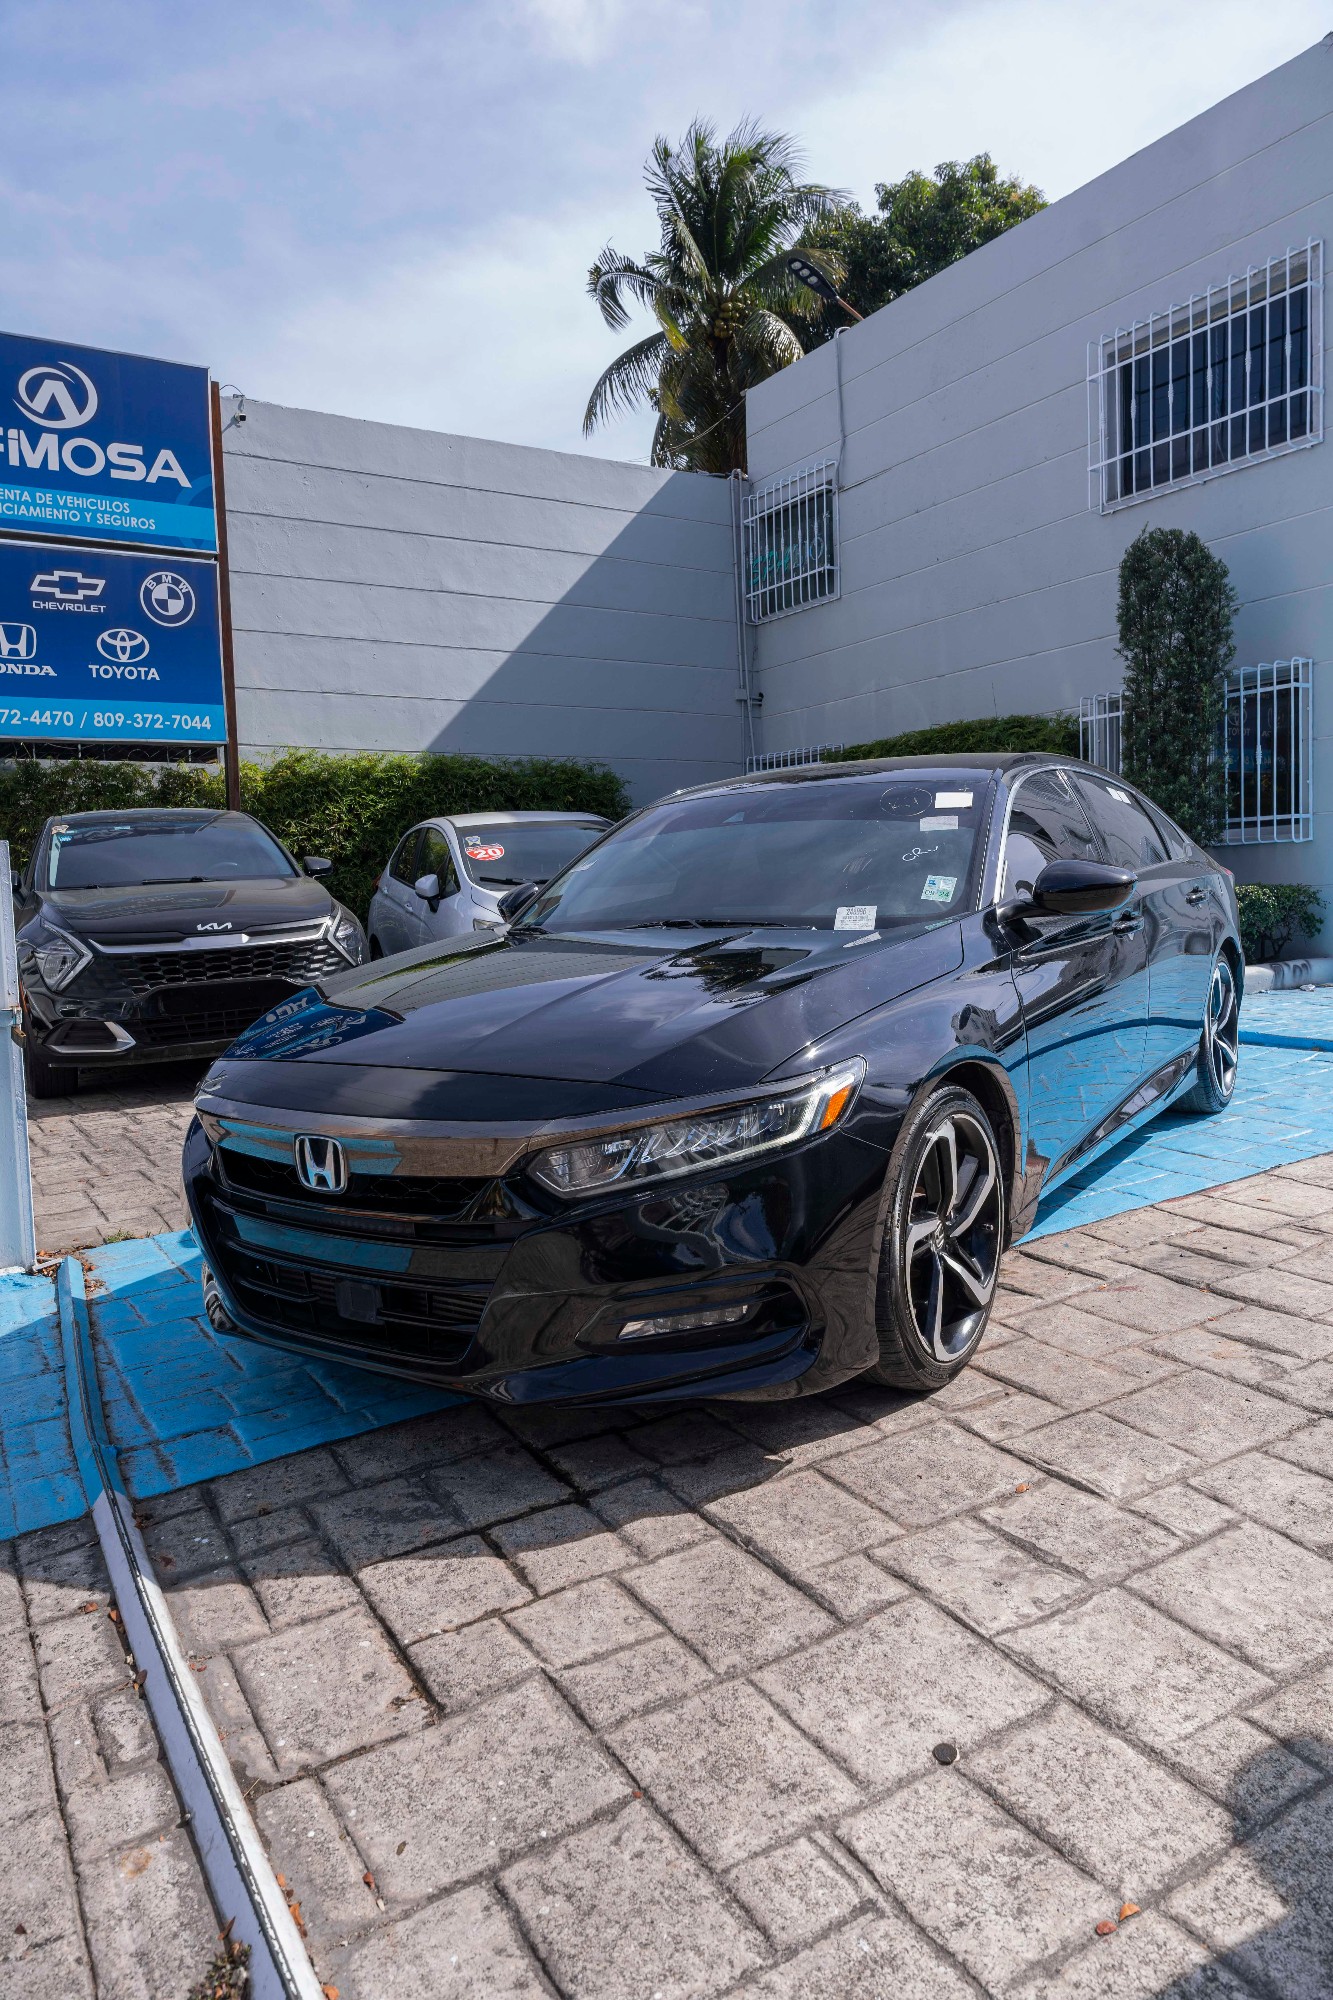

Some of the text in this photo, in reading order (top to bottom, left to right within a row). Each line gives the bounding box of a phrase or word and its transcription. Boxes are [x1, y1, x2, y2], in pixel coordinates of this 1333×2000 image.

[36, 492, 53, 505] DE
[57, 494, 130, 514] VEHICULOS
[0, 502, 156, 530] CIAMIENTO Y SEGUROS
[146, 574, 190, 593] BMW
[32, 600, 107, 613] CHEVROLET
[89, 664, 160, 681] TOYOTA
[93, 712, 212, 730] 809-372-7044
